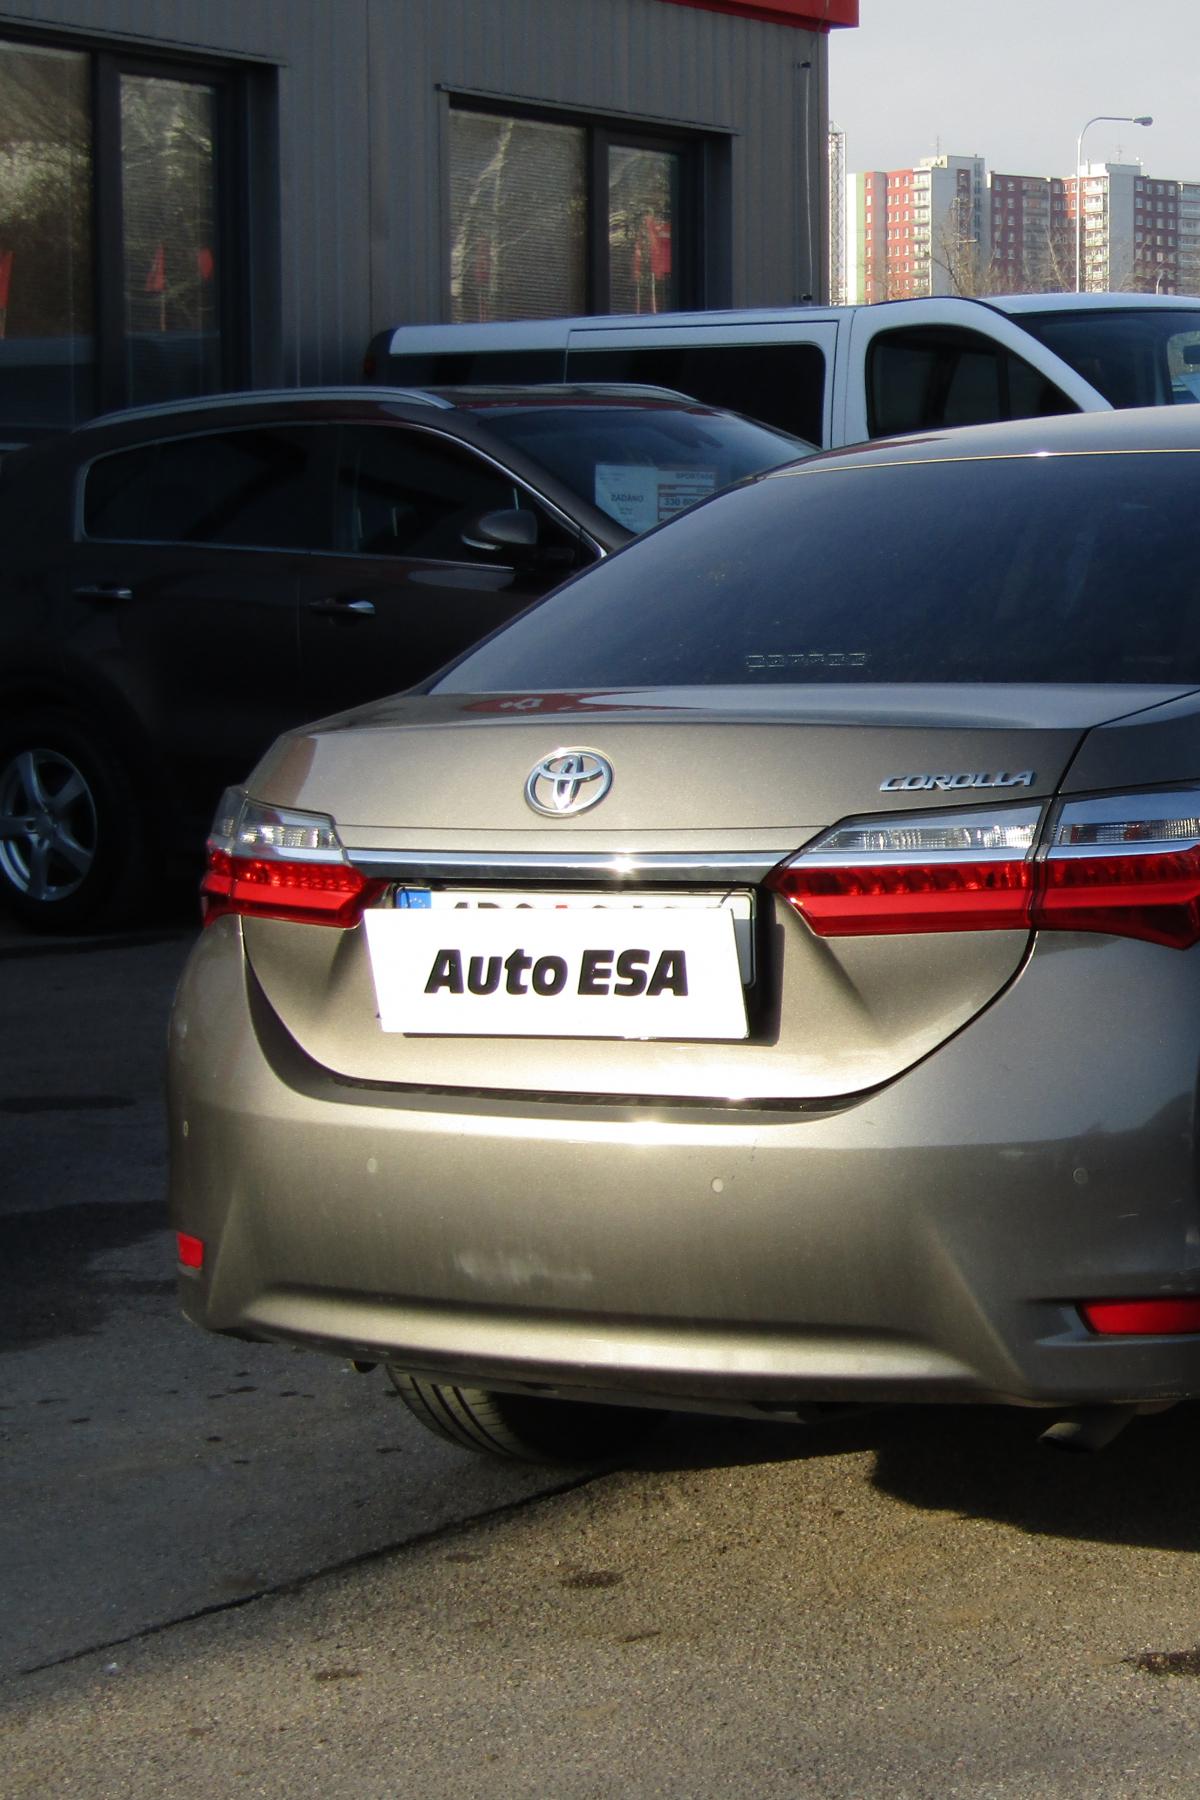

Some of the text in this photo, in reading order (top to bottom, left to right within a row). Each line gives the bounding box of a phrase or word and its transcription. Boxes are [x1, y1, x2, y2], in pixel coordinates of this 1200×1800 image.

[880, 770, 1036, 791] COROLLA
[424, 948, 689, 997] Auto ESA
